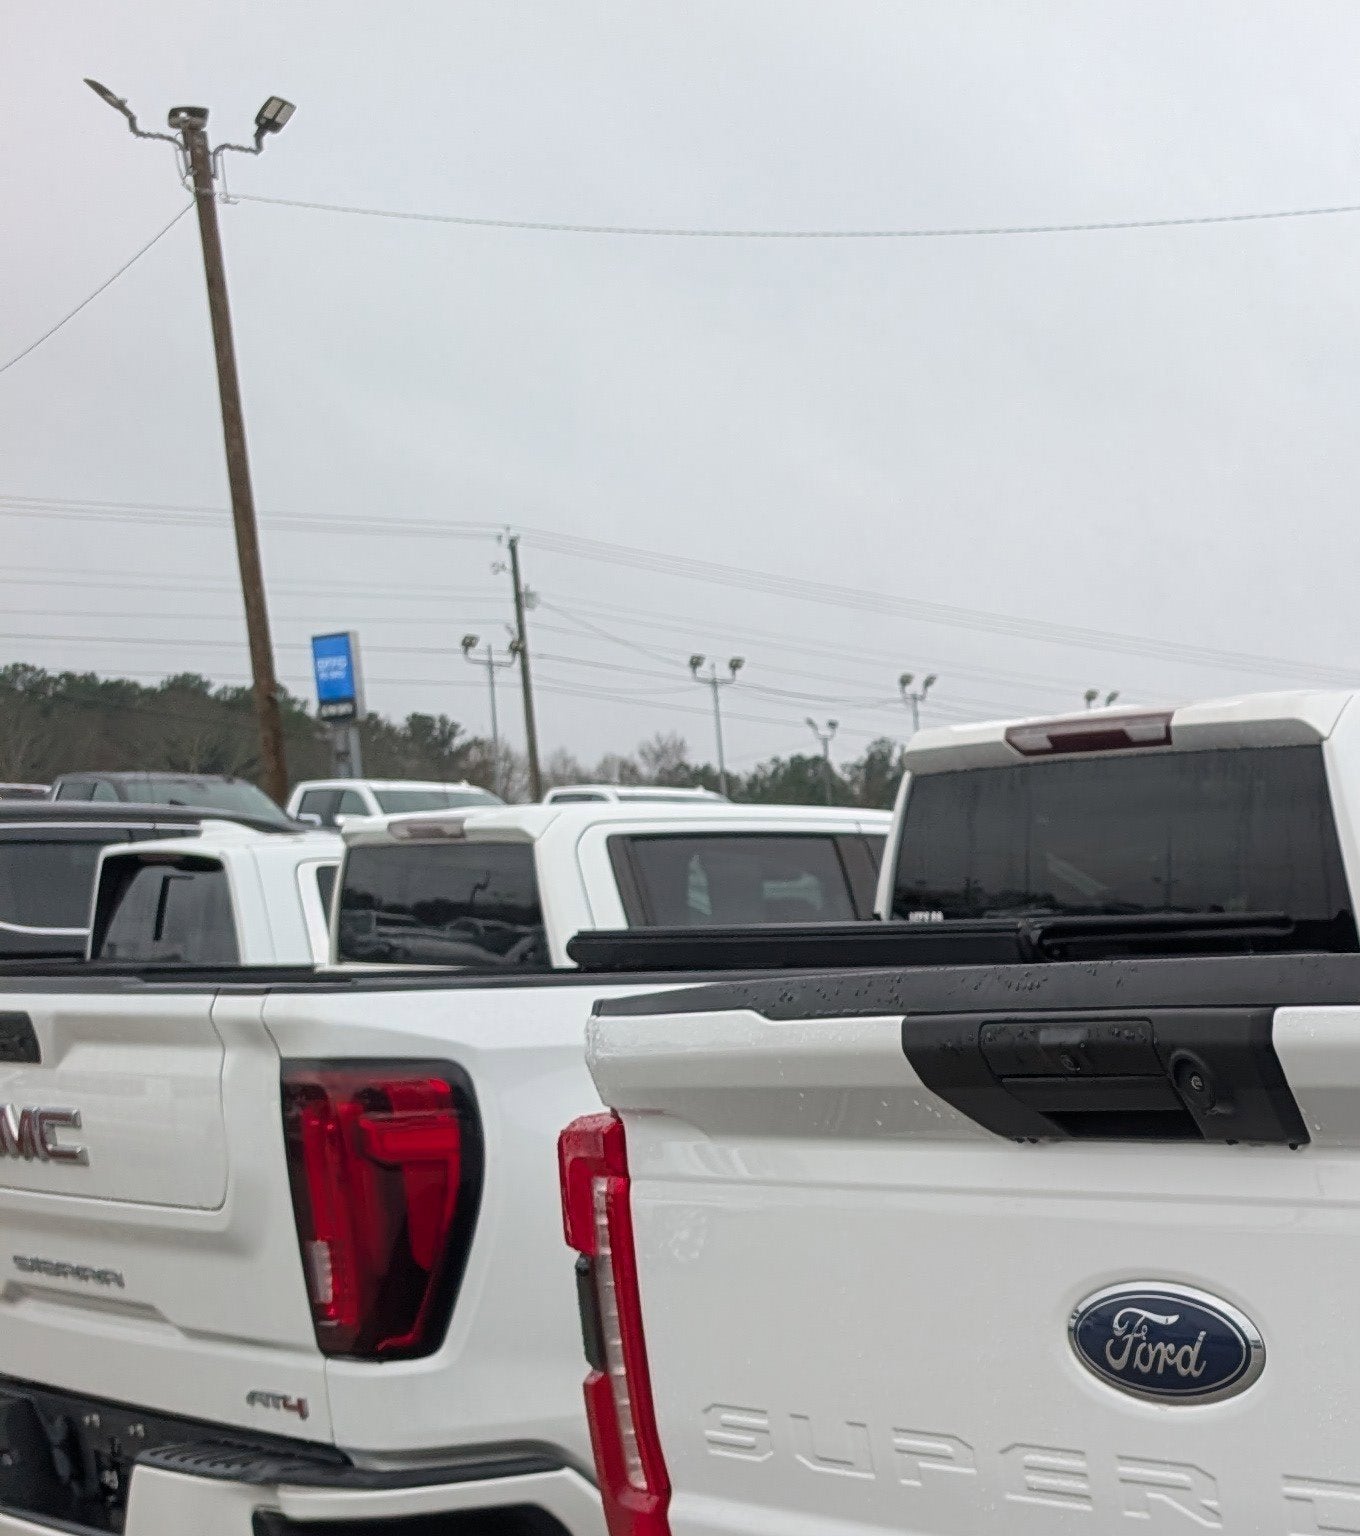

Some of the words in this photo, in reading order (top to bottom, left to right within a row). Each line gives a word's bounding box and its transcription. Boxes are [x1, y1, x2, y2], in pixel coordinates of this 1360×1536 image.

[0, 1104, 90, 1167] MC
[1105, 1306, 1207, 1377] Ford
[703, 1403, 1223, 1529] SUPER
